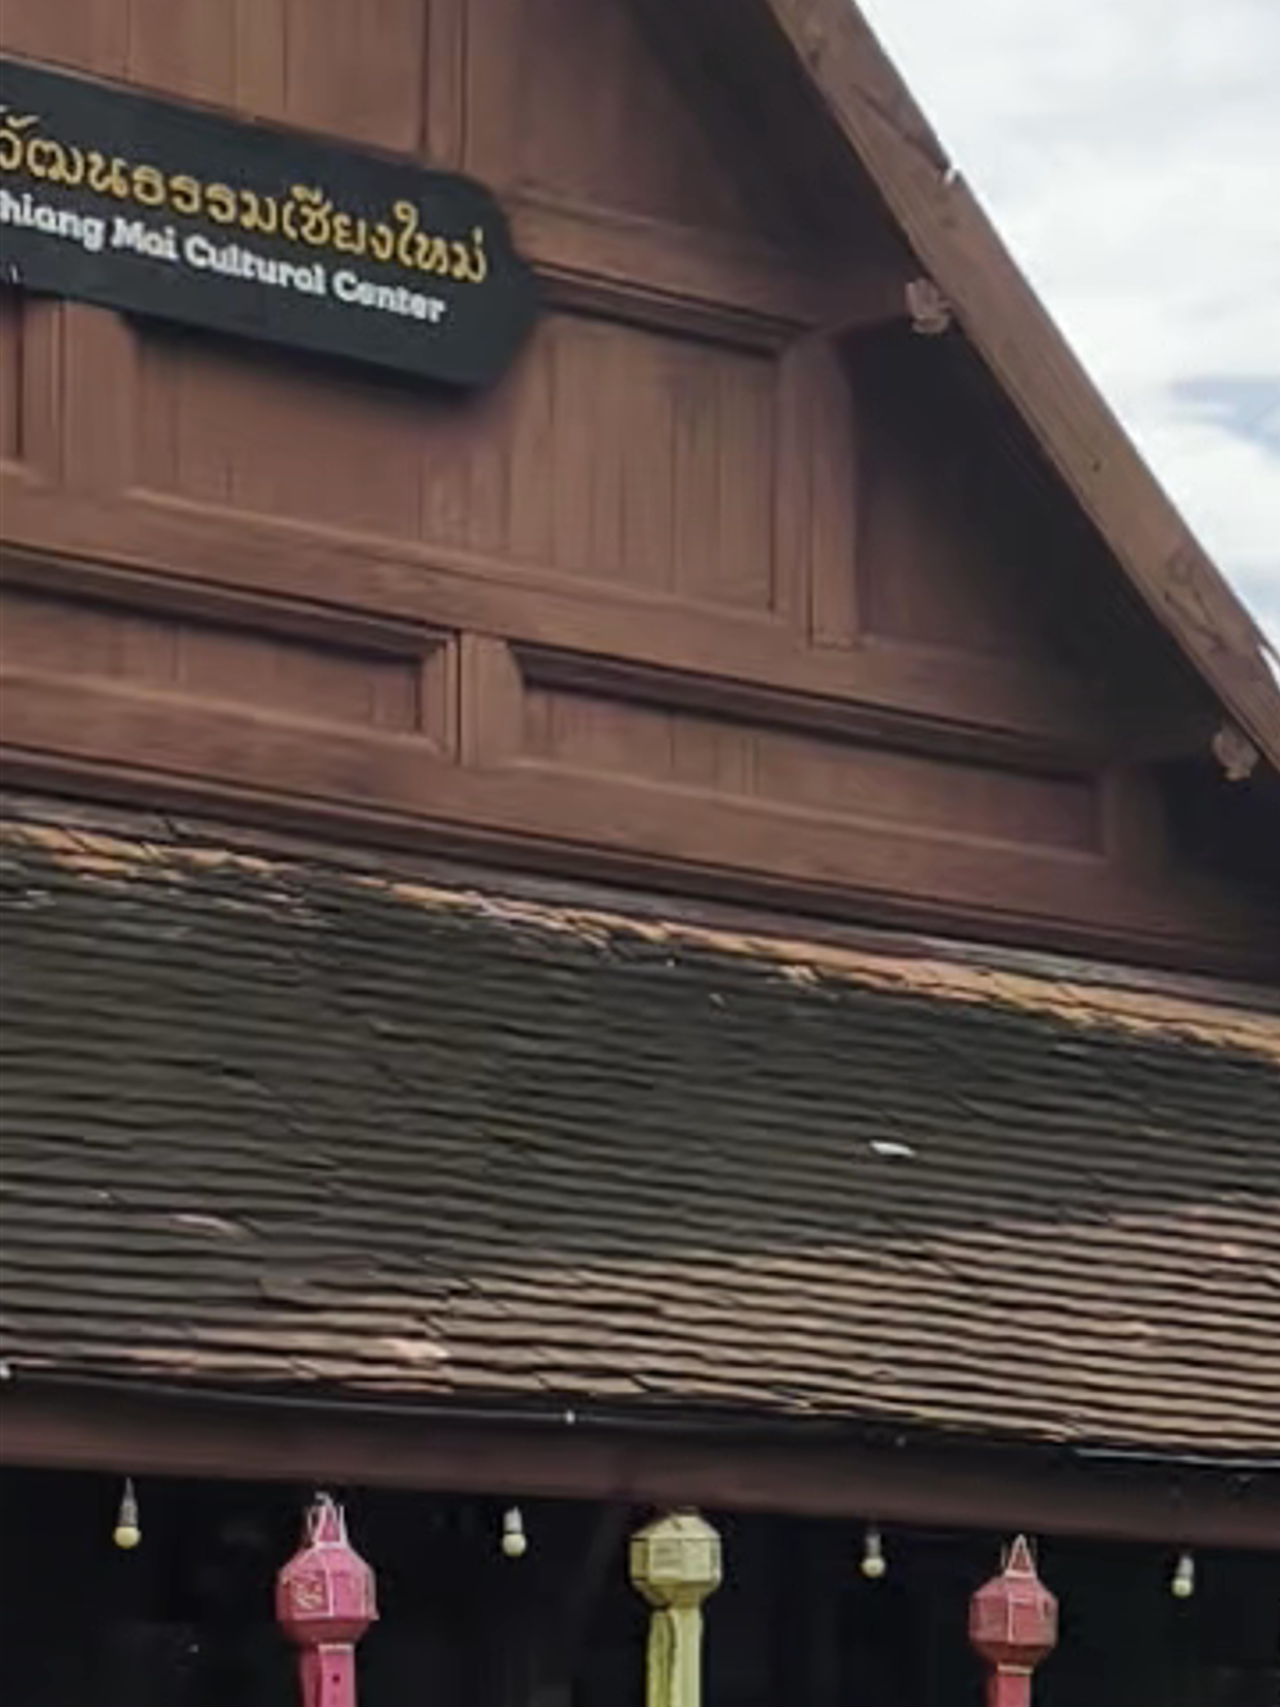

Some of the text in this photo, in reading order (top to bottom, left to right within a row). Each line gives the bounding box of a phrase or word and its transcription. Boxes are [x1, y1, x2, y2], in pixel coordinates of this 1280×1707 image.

[0, 105, 487, 282] วัฒนธรรมเชียงใหม่
[0, 189, 446, 322] hiang Mai Cultural Center
